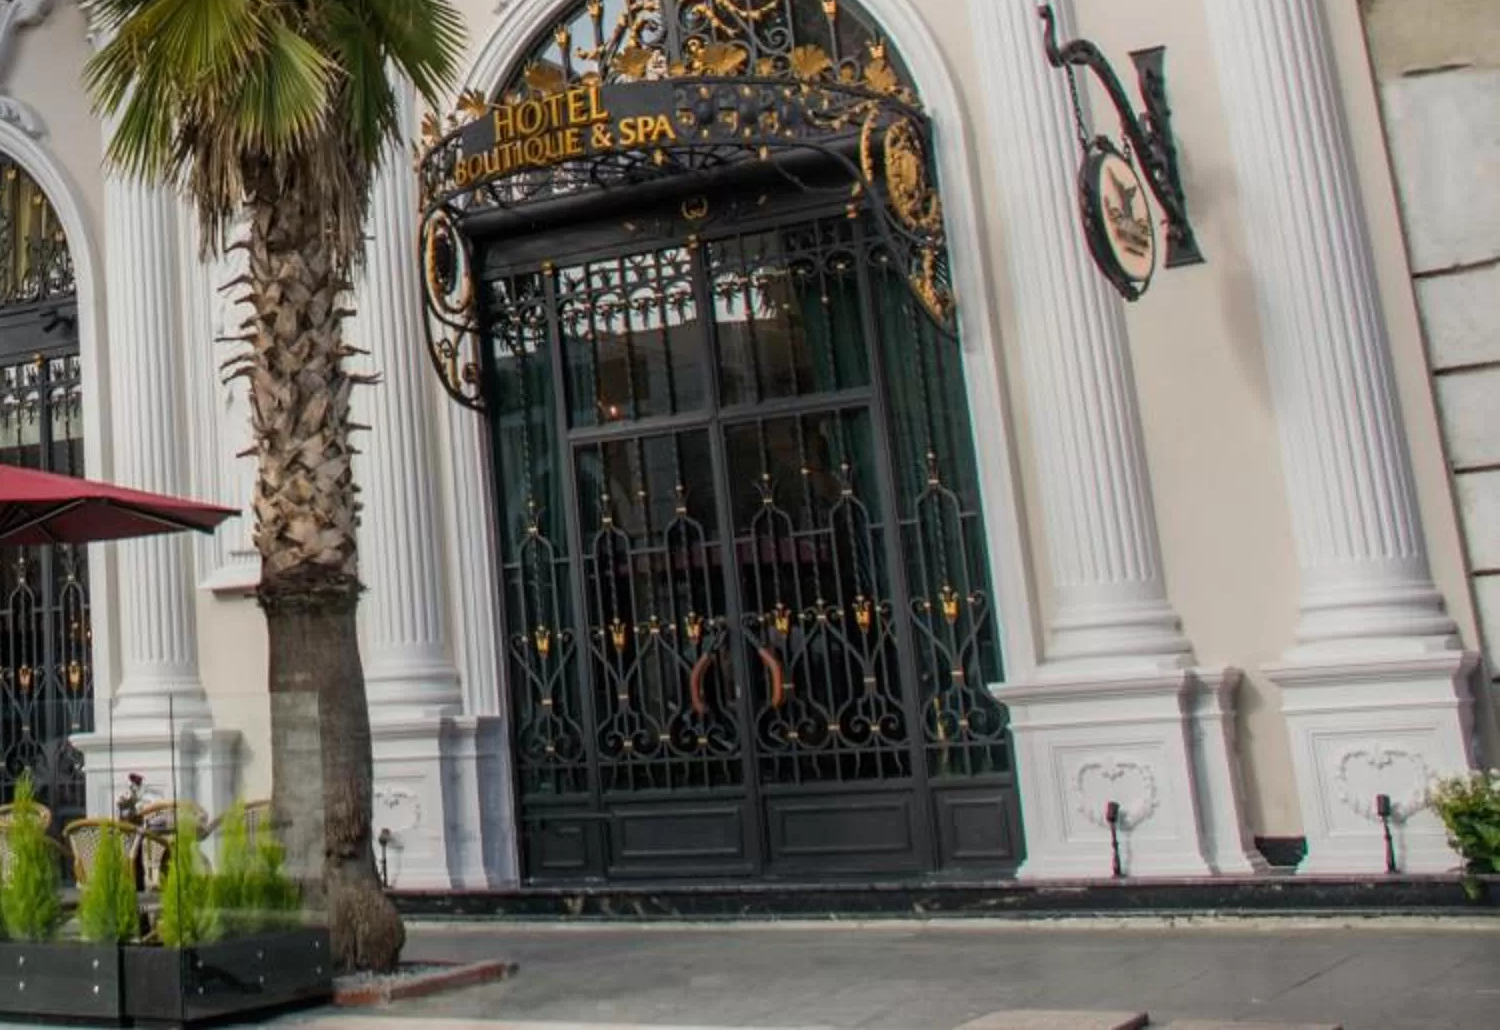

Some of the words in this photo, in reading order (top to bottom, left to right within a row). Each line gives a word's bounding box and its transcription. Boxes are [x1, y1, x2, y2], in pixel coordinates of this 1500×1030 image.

[493, 85, 609, 141] HOTEL
[454, 127, 583, 186] BOUTIQUE
[591, 122, 613, 149] &
[619, 114, 677, 146] SPA
